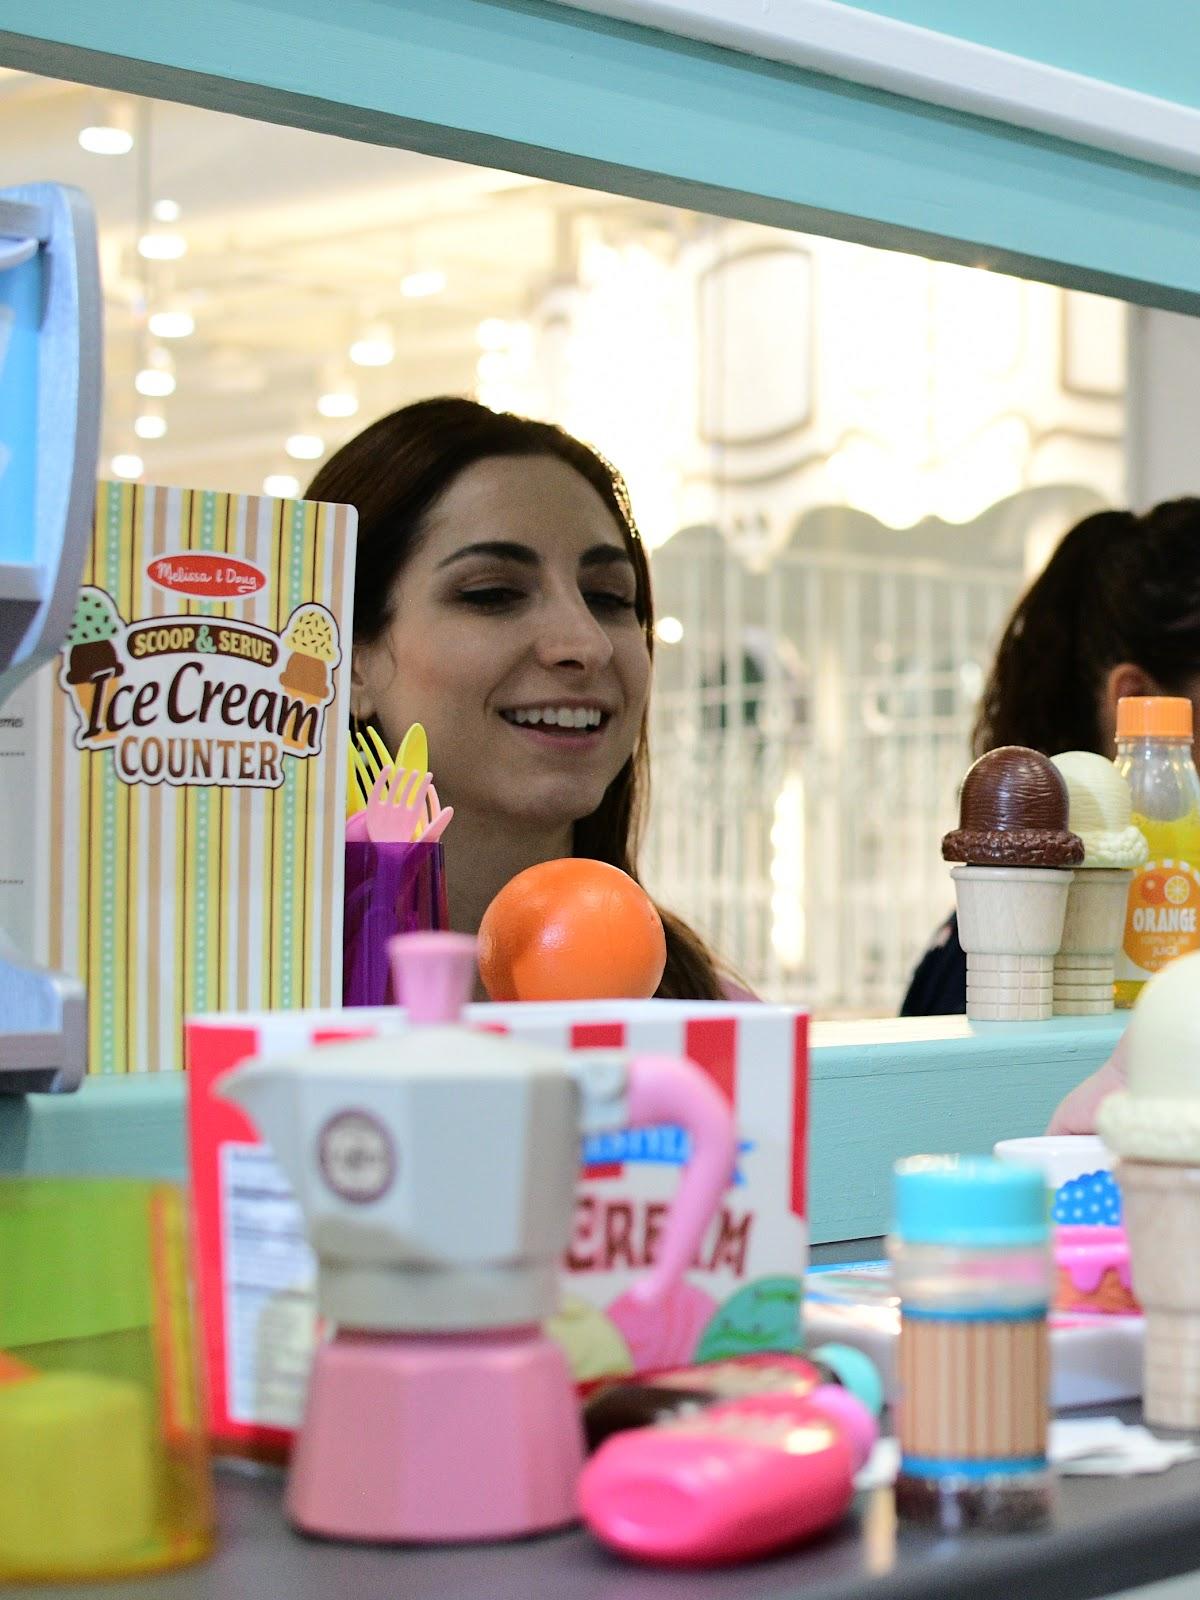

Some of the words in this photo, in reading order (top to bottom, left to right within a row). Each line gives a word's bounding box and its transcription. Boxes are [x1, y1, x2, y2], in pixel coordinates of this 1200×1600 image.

[156, 561, 213, 585] Melissa
[225, 567, 257, 593] Doug
[133, 626, 194, 657] SCOOP
[195, 624, 217, 654] &
[218, 631, 274, 664] SERVE
[82, 666, 160, 740] Ice
[166, 661, 320, 748] Cream
[119, 735, 280, 782] COUNTER
[1132, 907, 1197, 933] ORANGE
[564, 1197, 755, 1281] CREM
